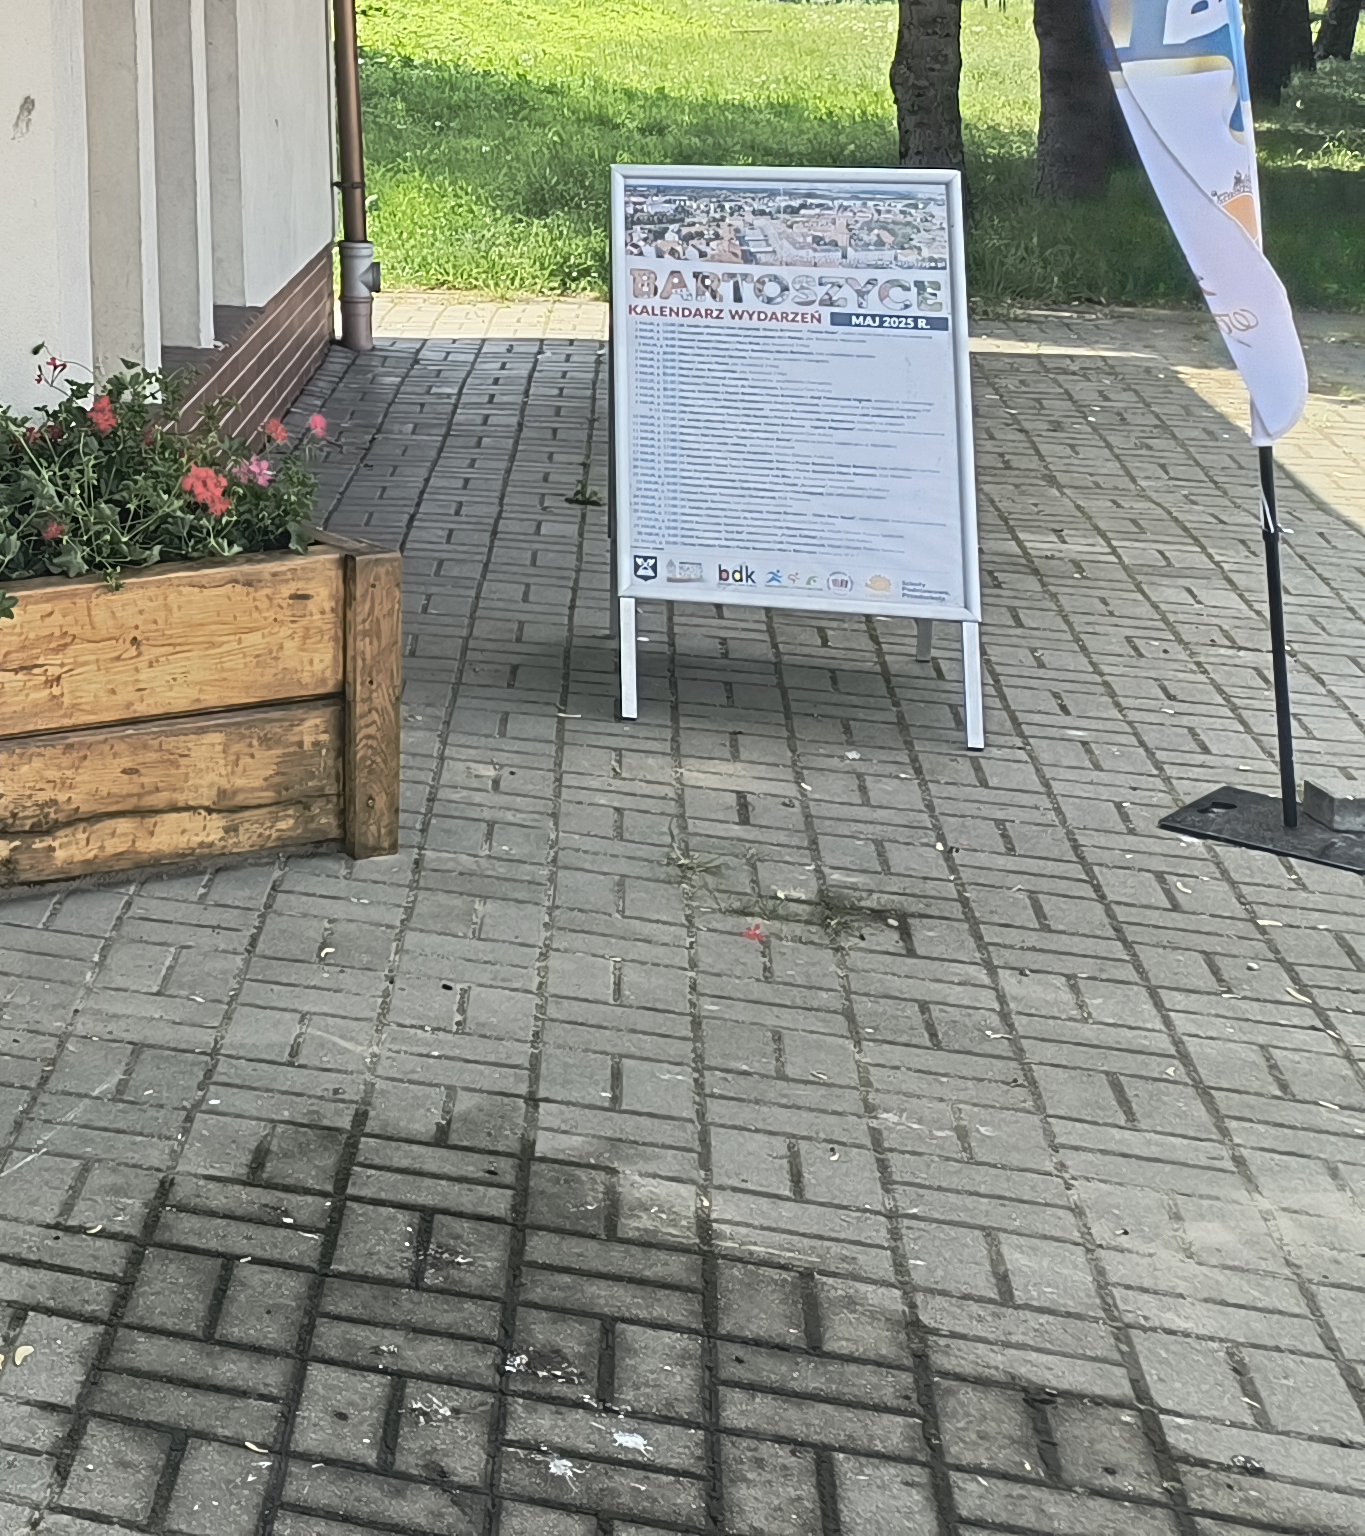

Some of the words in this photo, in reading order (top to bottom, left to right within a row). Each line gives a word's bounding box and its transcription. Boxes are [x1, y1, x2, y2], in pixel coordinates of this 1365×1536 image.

[630, 268, 943, 312] BARTOSZYCE
[628, 304, 724, 320] KALENDARZ
[728, 309, 822, 324] WYDARZEŃ
[851, 315, 879, 327] MAJ
[883, 317, 914, 328] 2025
[918, 318, 930, 329] R.
[718, 564, 756, 584] bdk
